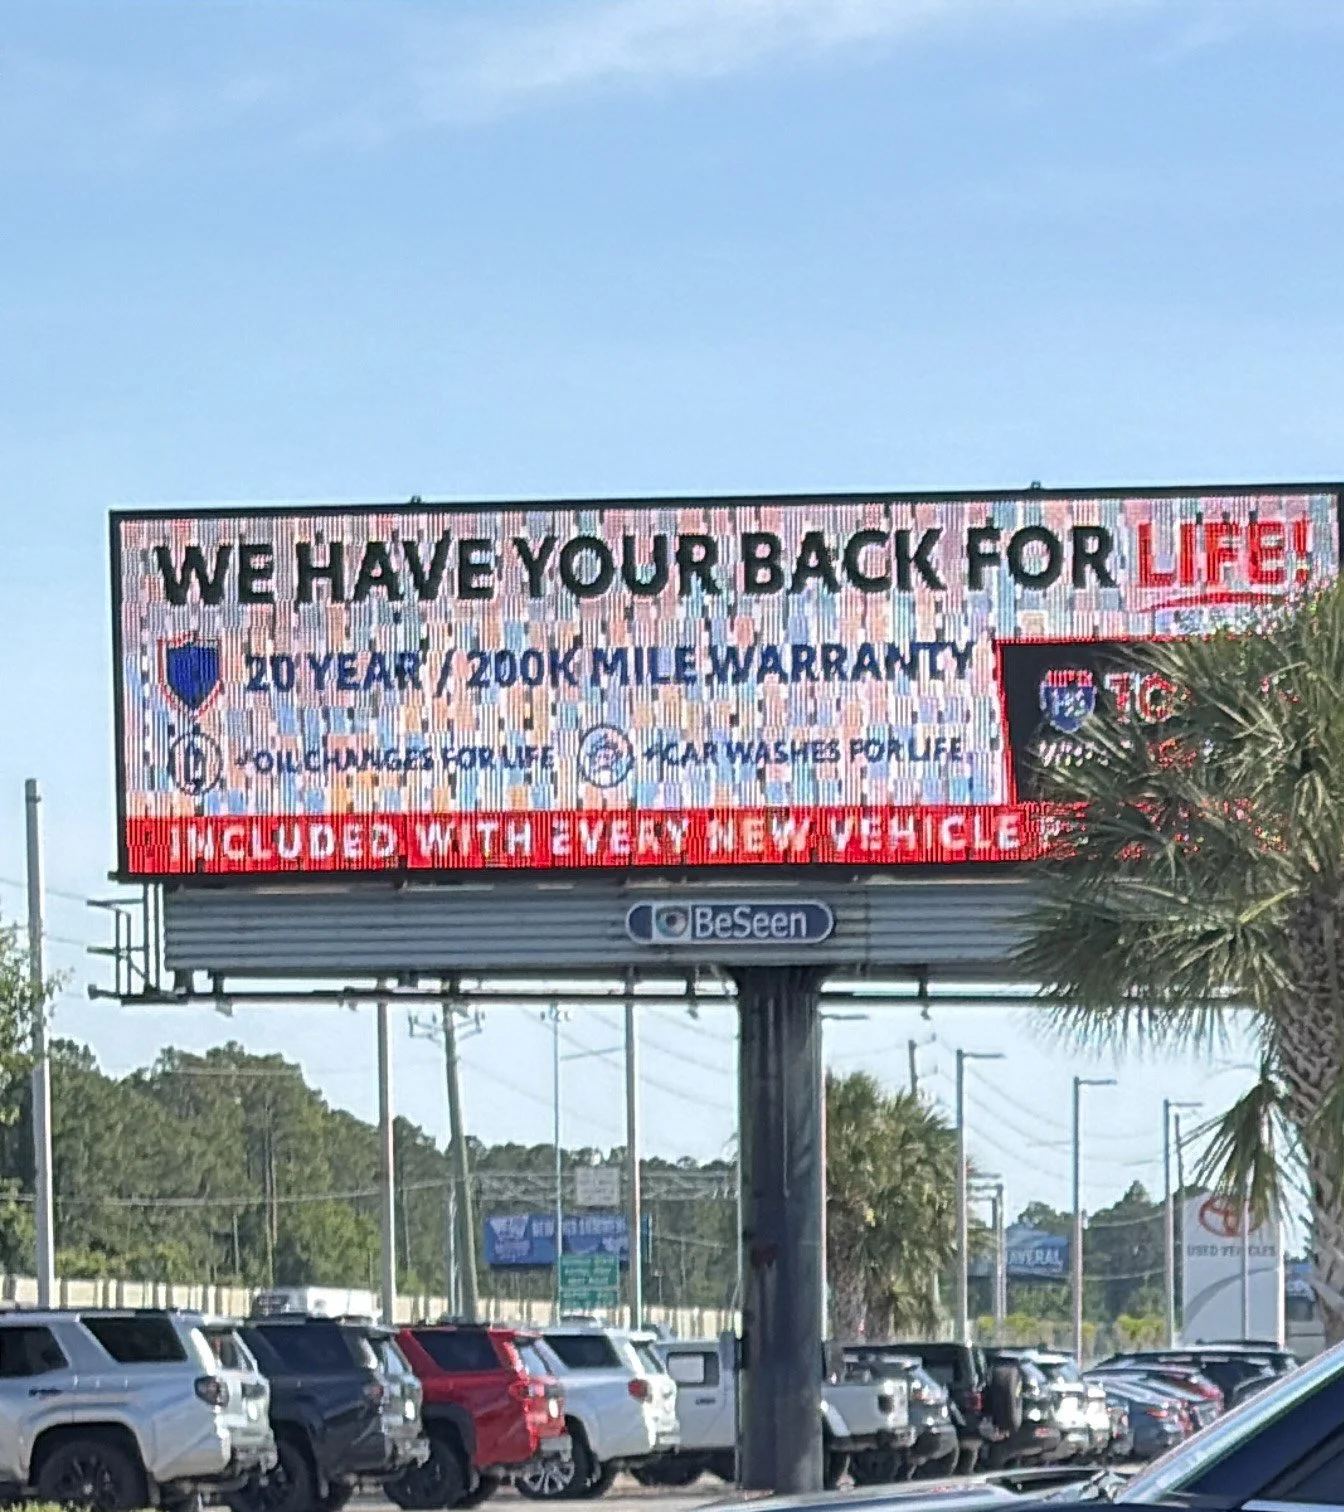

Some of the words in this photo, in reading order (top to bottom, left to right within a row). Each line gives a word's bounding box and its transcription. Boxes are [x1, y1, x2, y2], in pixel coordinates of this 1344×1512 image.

[153, 542, 274, 605] WE
[298, 537, 496, 604] HAVE
[513, 533, 724, 600] YOUR
[740, 526, 947, 595] BACK
[967, 525, 1118, 592] FOR
[1137, 517, 1311, 588] LIFE!
[245, 653, 296, 694] 20
[309, 650, 424, 692] YEAR
[466, 648, 579, 690] 200K
[590, 645, 699, 686] MILE
[708, 640, 975, 685] WARRANTY
[304, 746, 435, 774] CHANGES
[441, 746, 498, 772] FOR
[501, 745, 556, 771] LIFE
[727, 736, 842, 765] WASHES
[849, 737, 902, 764] FOR
[908, 735, 964, 763] LIFE
[169, 819, 399, 863] INCLUDED
[416, 818, 533, 858] WITH
[551, 815, 691, 857] EVERY
[707, 815, 814, 854] NEW
[829, 812, 1022, 853] VEHICLE
[695, 905, 808, 939] BeSeen
